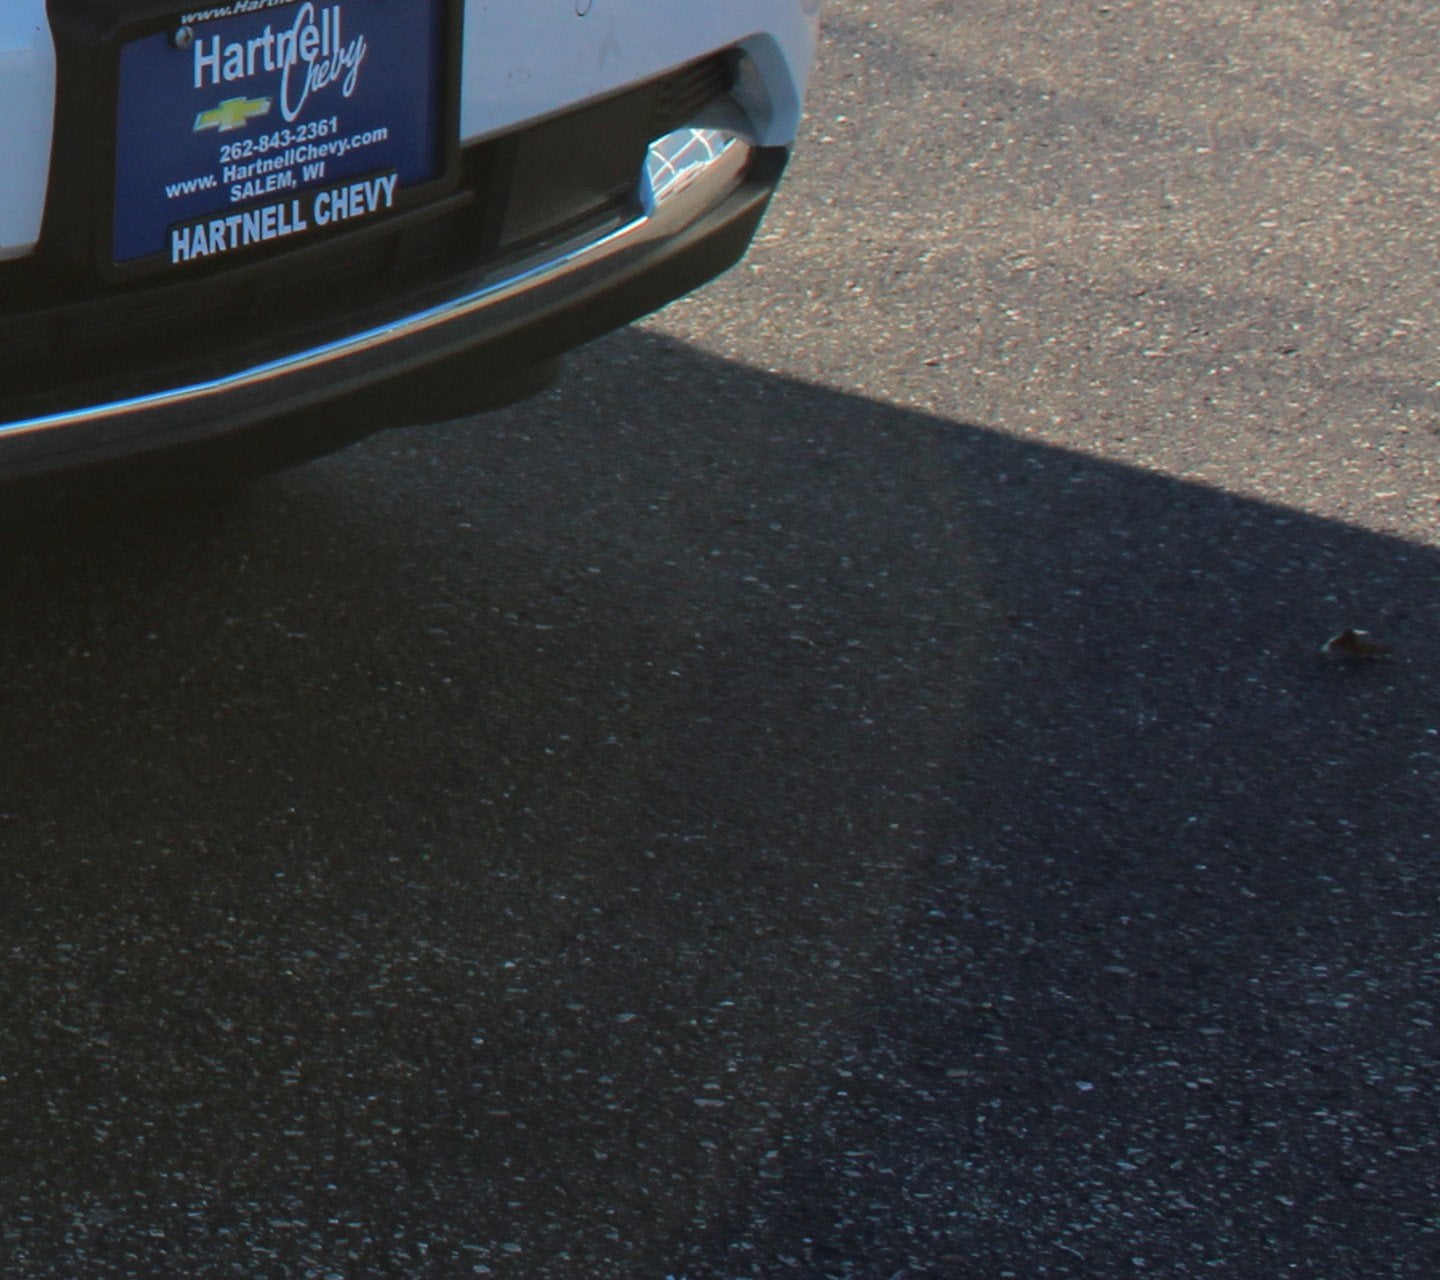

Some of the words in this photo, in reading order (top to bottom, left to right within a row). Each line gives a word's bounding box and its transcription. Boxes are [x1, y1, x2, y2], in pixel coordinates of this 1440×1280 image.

[193, 4, 341, 89] Hartnell
[280, 1, 368, 123] Chevy
[164, 173, 218, 200] www.
[223, 127, 389, 185] HartnellChevy.com
[219, 116, 339, 164] 262-843-2361
[171, 199, 308, 264] HARTNELL
[313, 173, 399, 227] CHEVY
[230, 170, 298, 203] SALEM,
[302, 160, 326, 183] WI
